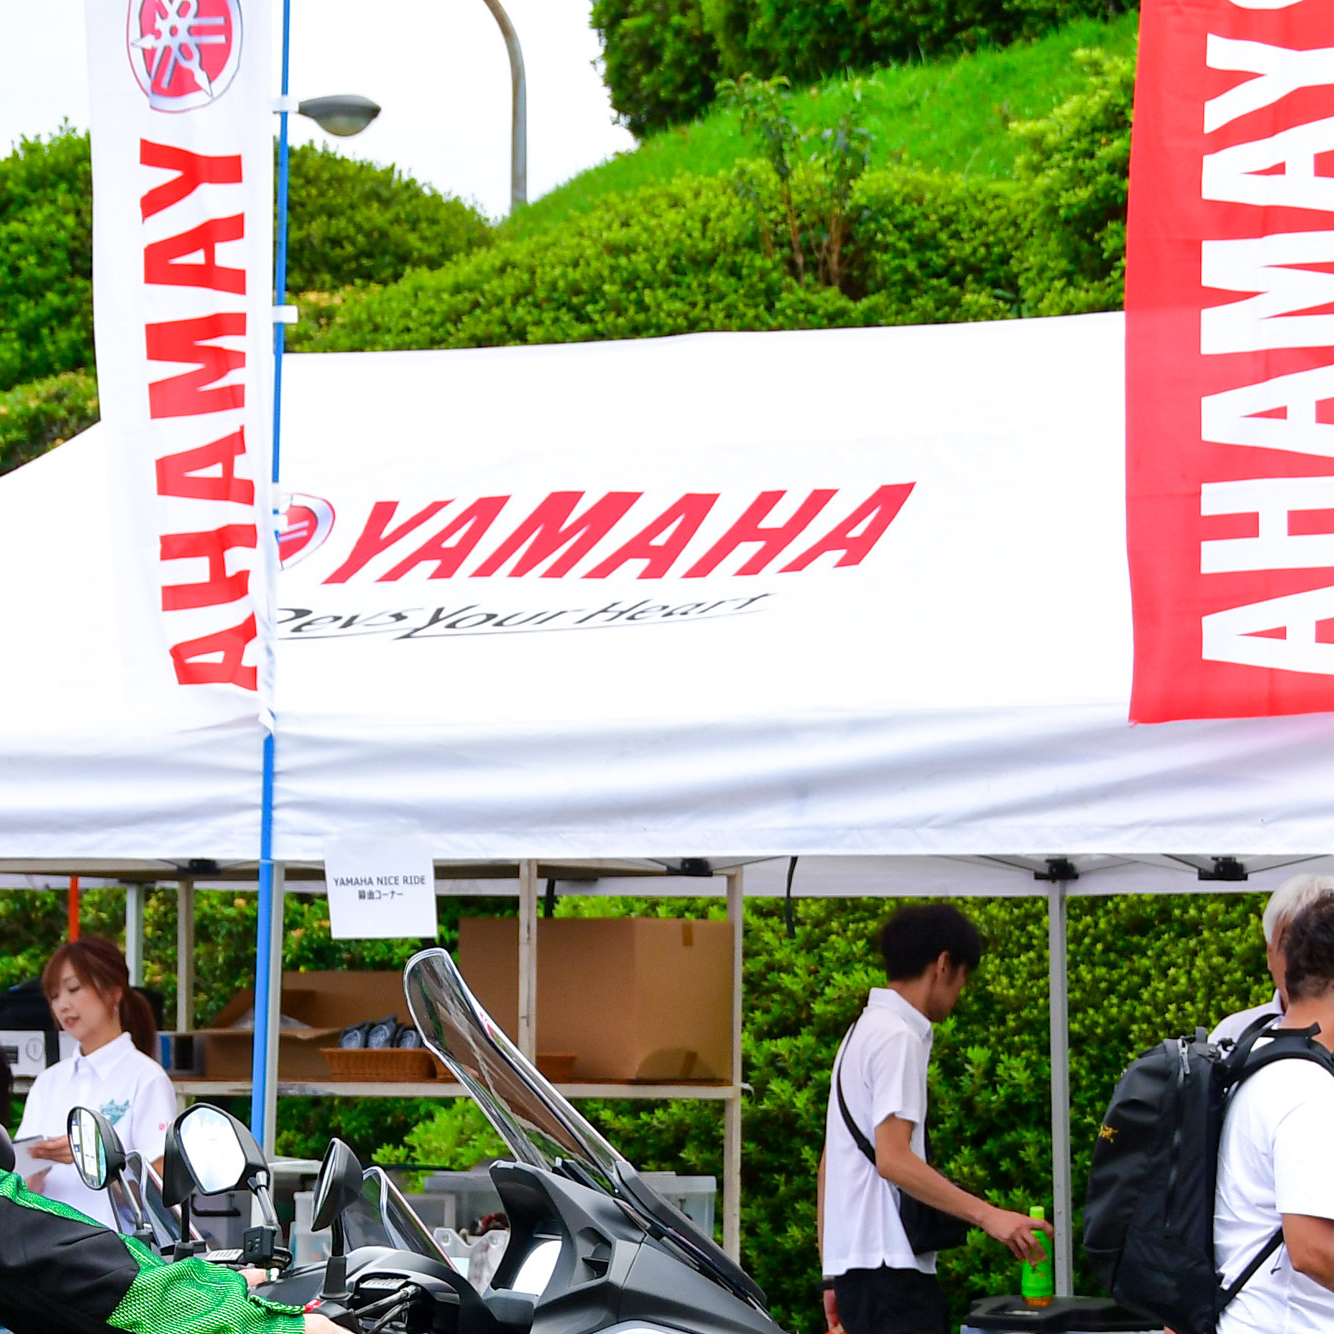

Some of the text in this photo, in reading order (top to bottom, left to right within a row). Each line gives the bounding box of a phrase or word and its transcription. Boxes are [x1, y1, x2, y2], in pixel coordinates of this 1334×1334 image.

[321, 481, 917, 585] YAMAHA
[394, 604, 577, 640] Your
[579, 592, 775, 627] Heart
[334, 874, 426, 887] YAMAHA NICE RIDE
